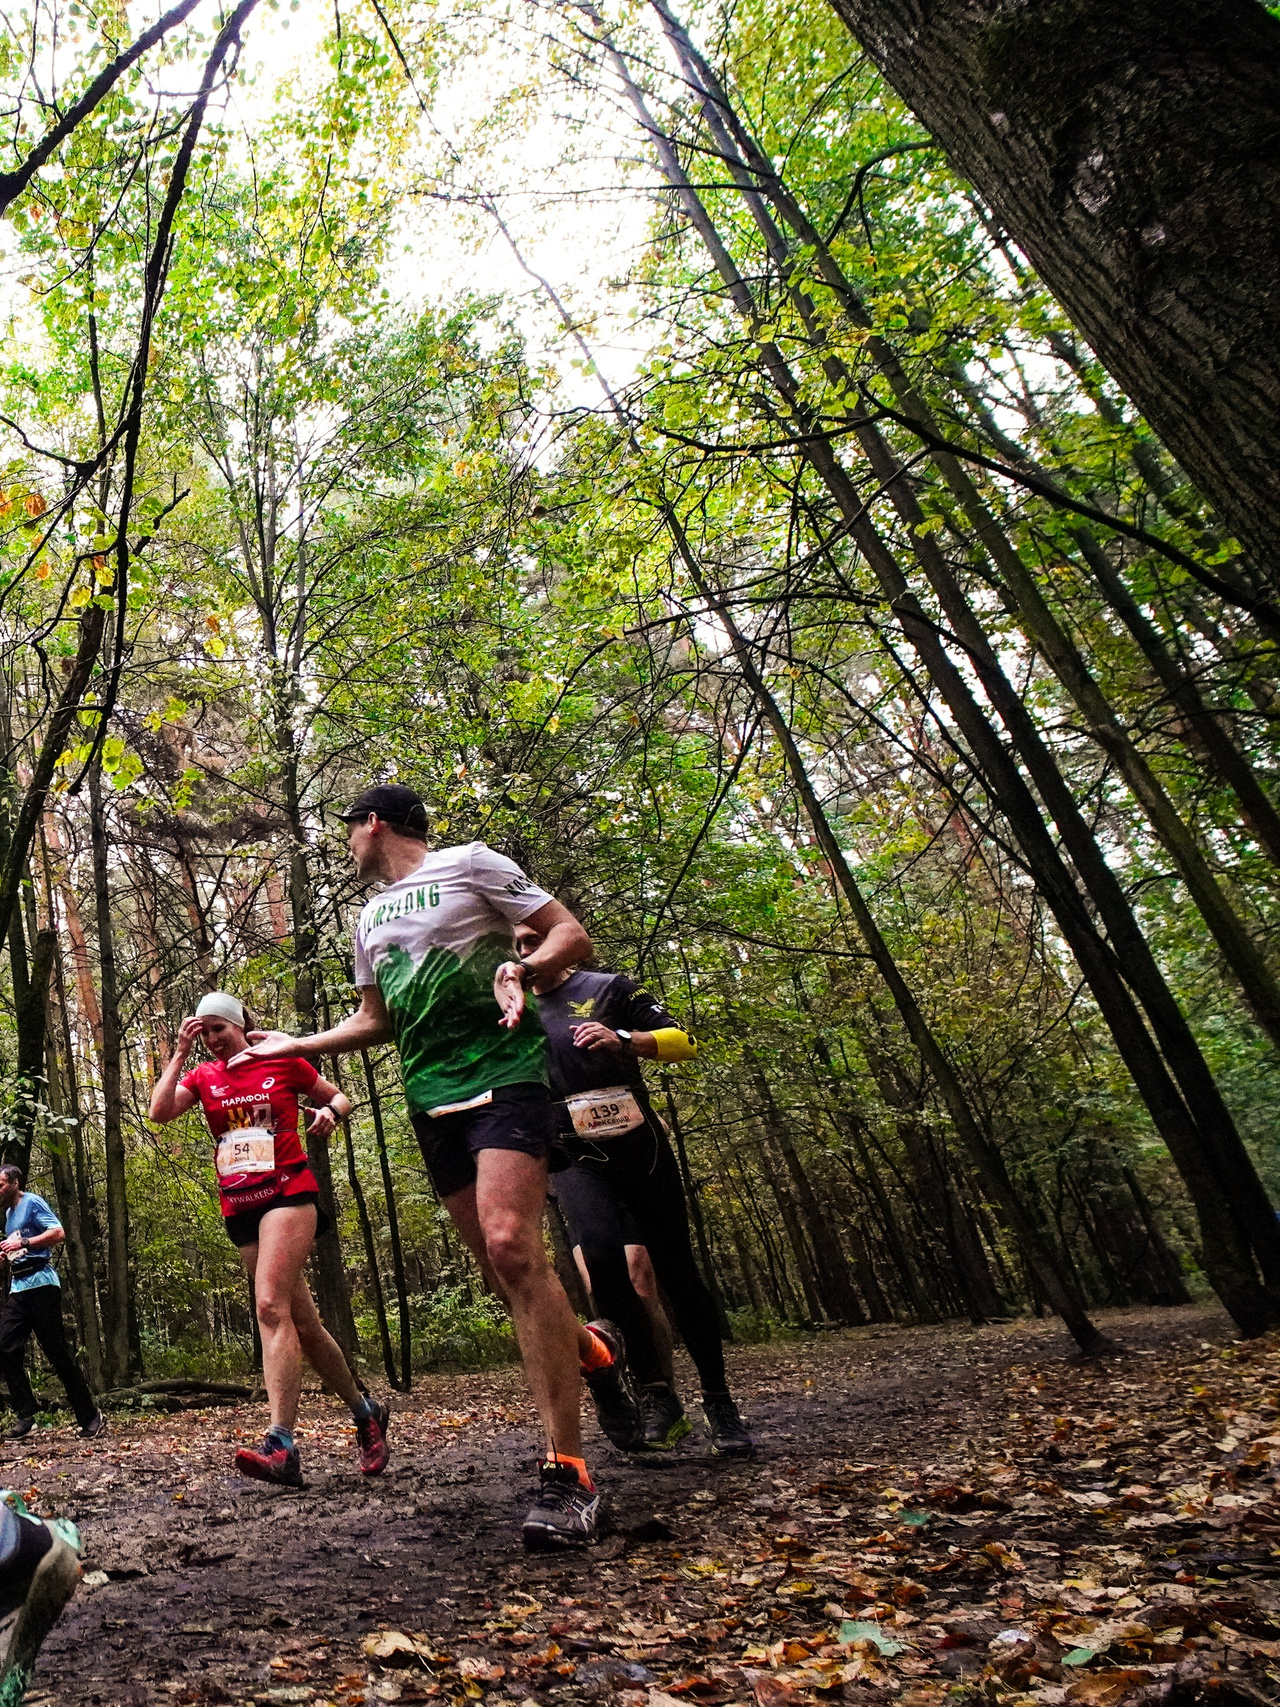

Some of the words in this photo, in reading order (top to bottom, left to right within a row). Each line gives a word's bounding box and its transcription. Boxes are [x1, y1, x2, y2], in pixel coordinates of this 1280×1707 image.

[221, 1093, 270, 1108] МАРАФОН
[590, 1103, 620, 1119] 139
[234, 1142, 250, 1156] 54
